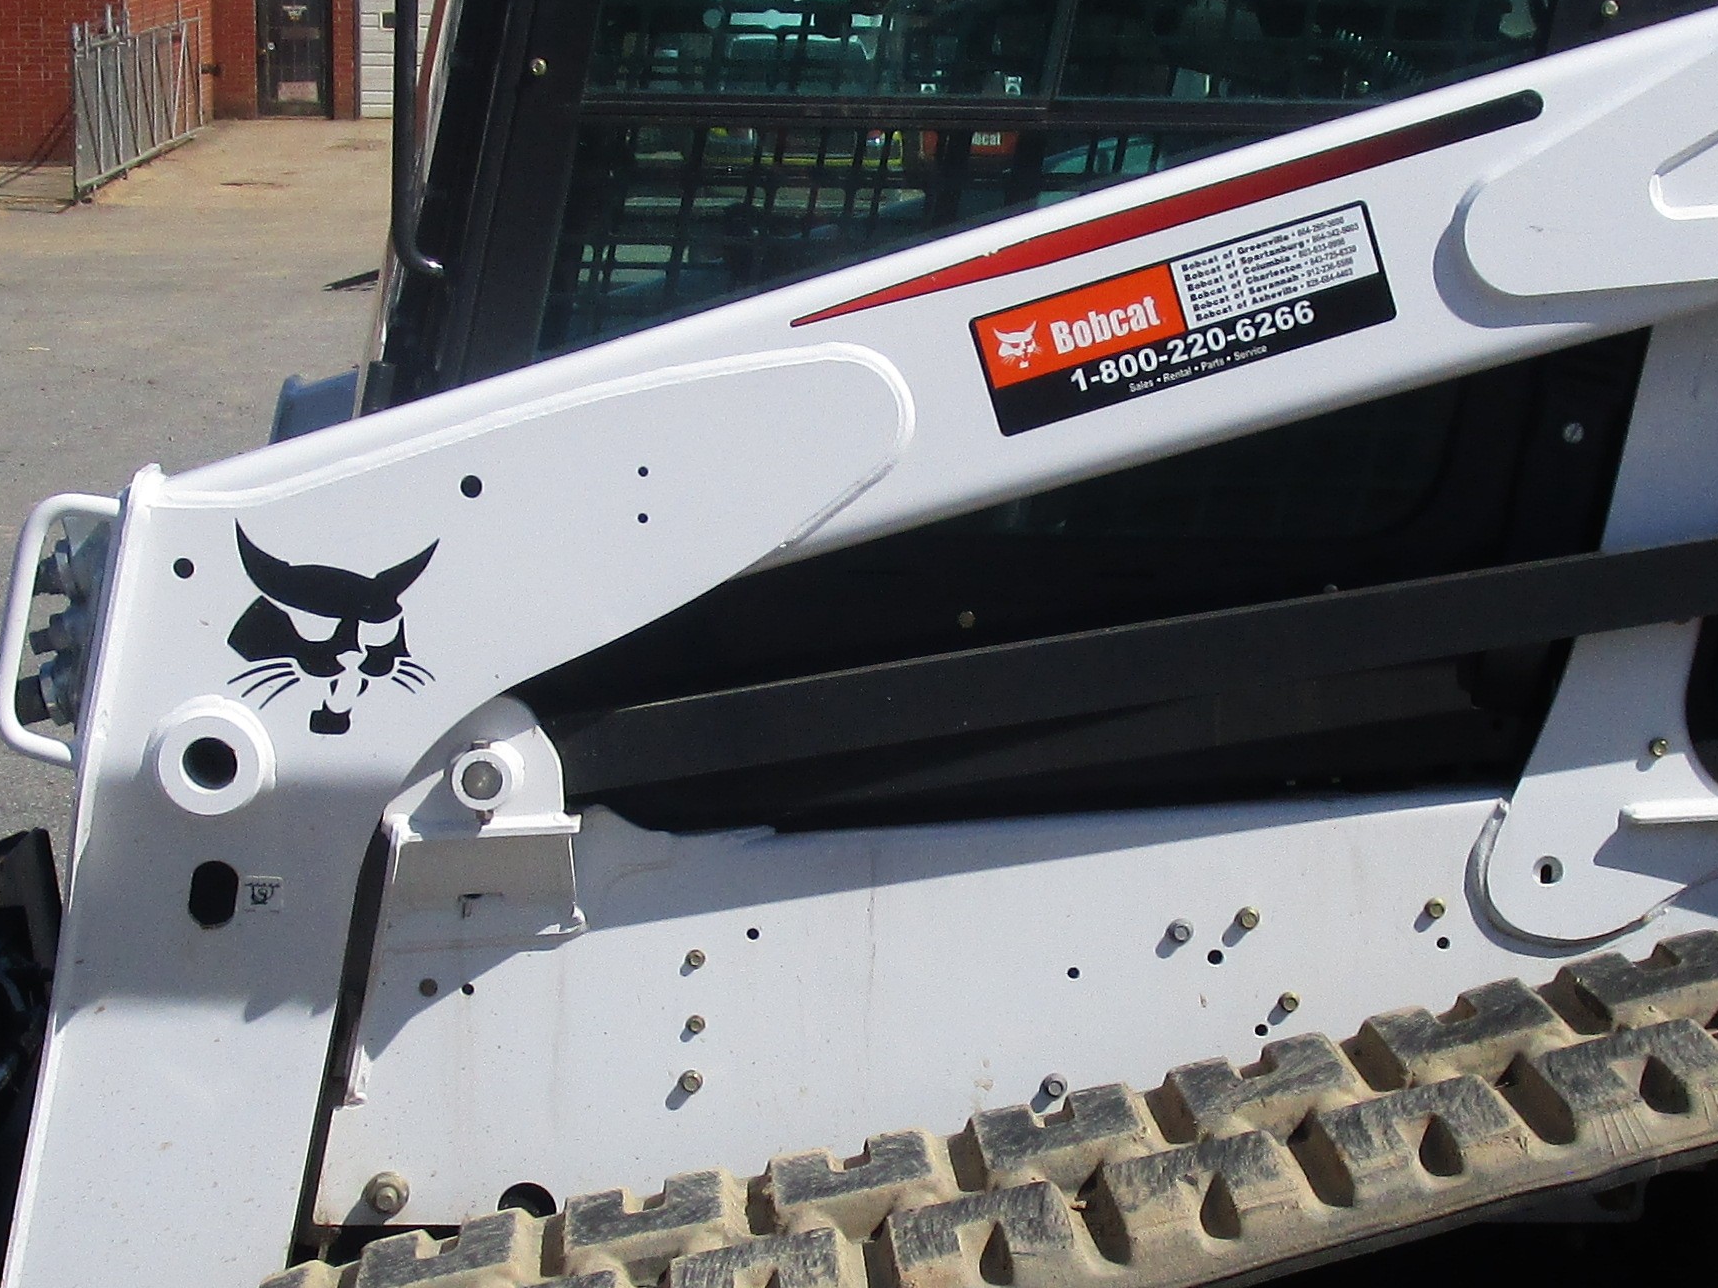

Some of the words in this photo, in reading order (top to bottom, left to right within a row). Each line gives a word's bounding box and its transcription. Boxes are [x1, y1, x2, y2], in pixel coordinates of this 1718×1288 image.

[1182, 255, 1218, 271] Bobcat
[1222, 249, 1233, 260] of
[1237, 235, 1289, 255] Greenville
[1184, 265, 1221, 281] Bobcat
[1225, 259, 1236, 270] of
[1240, 241, 1304, 265] Spartanburg
[1187, 274, 1224, 291] Bobcat
[1228, 269, 1239, 280] of
[1243, 256, 1291, 274] Columbia
[1190, 285, 1227, 301] Bobcat
[1231, 279, 1242, 290] of
[1246, 263, 1302, 285] Charleston
[1193, 295, 1229, 311] Bobcat
[1234, 289, 1245, 300] of
[1249, 274, 1299, 295] Savannah
[1196, 305, 1233, 321] Bobcat
[1237, 299, 1248, 310] of
[1252, 286, 1298, 305] Asheville
[1049, 295, 1160, 355] Bobcat
[1070, 300, 1316, 392] 1-800-220-6266
[1129, 378, 1154, 393] Sales
[1162, 366, 1192, 383] Rental
[1201, 357, 1225, 372] Parts
[1234, 344, 1268, 362] Service
